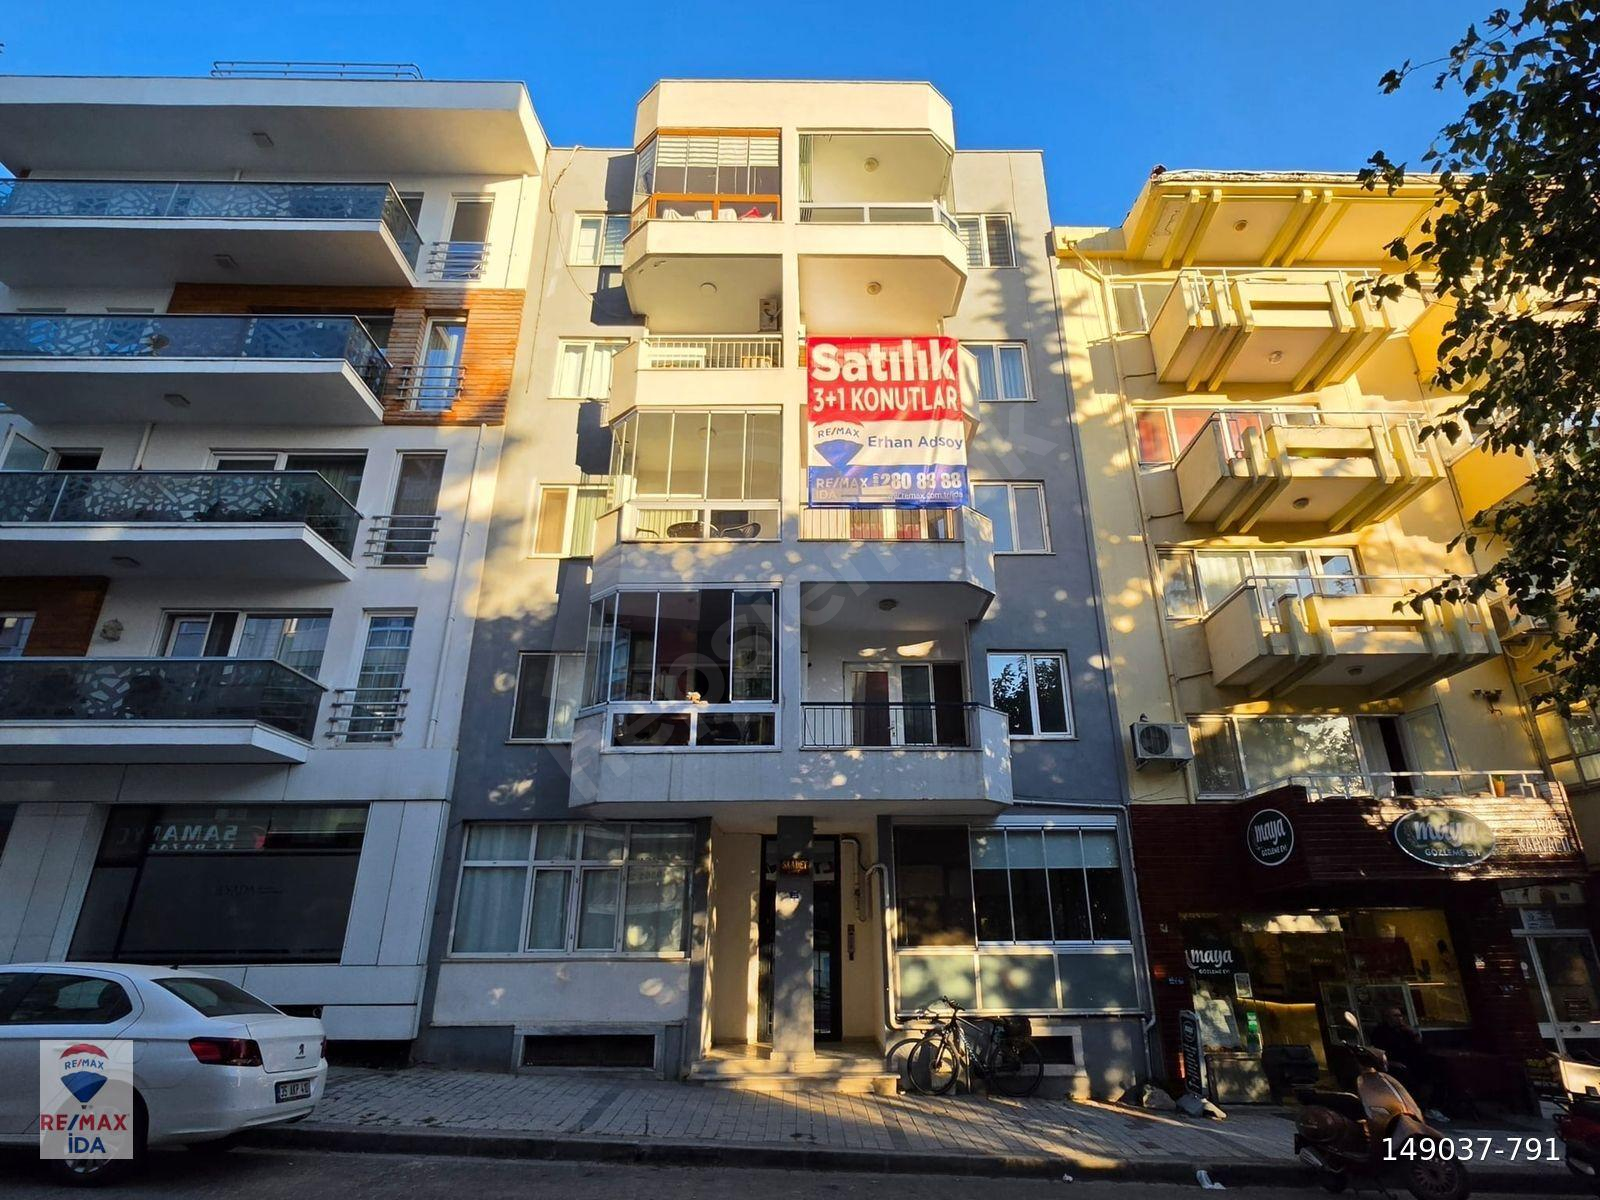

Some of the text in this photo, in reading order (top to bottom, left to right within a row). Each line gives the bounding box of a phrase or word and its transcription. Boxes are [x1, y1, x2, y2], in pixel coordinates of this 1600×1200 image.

[811, 339, 957, 382] Satılık
[812, 385, 959, 412] 3+1 KONUTLAR
[817, 427, 860, 439] RE/MAX
[868, 435, 963, 450] Erhan Adsoy
[816, 477, 868, 489] RE/MAX
[880, 472, 911, 490] 280
[1254, 818, 1287, 845] maya
[1414, 820, 1478, 848] maya
[1187, 948, 1234, 968] maya
